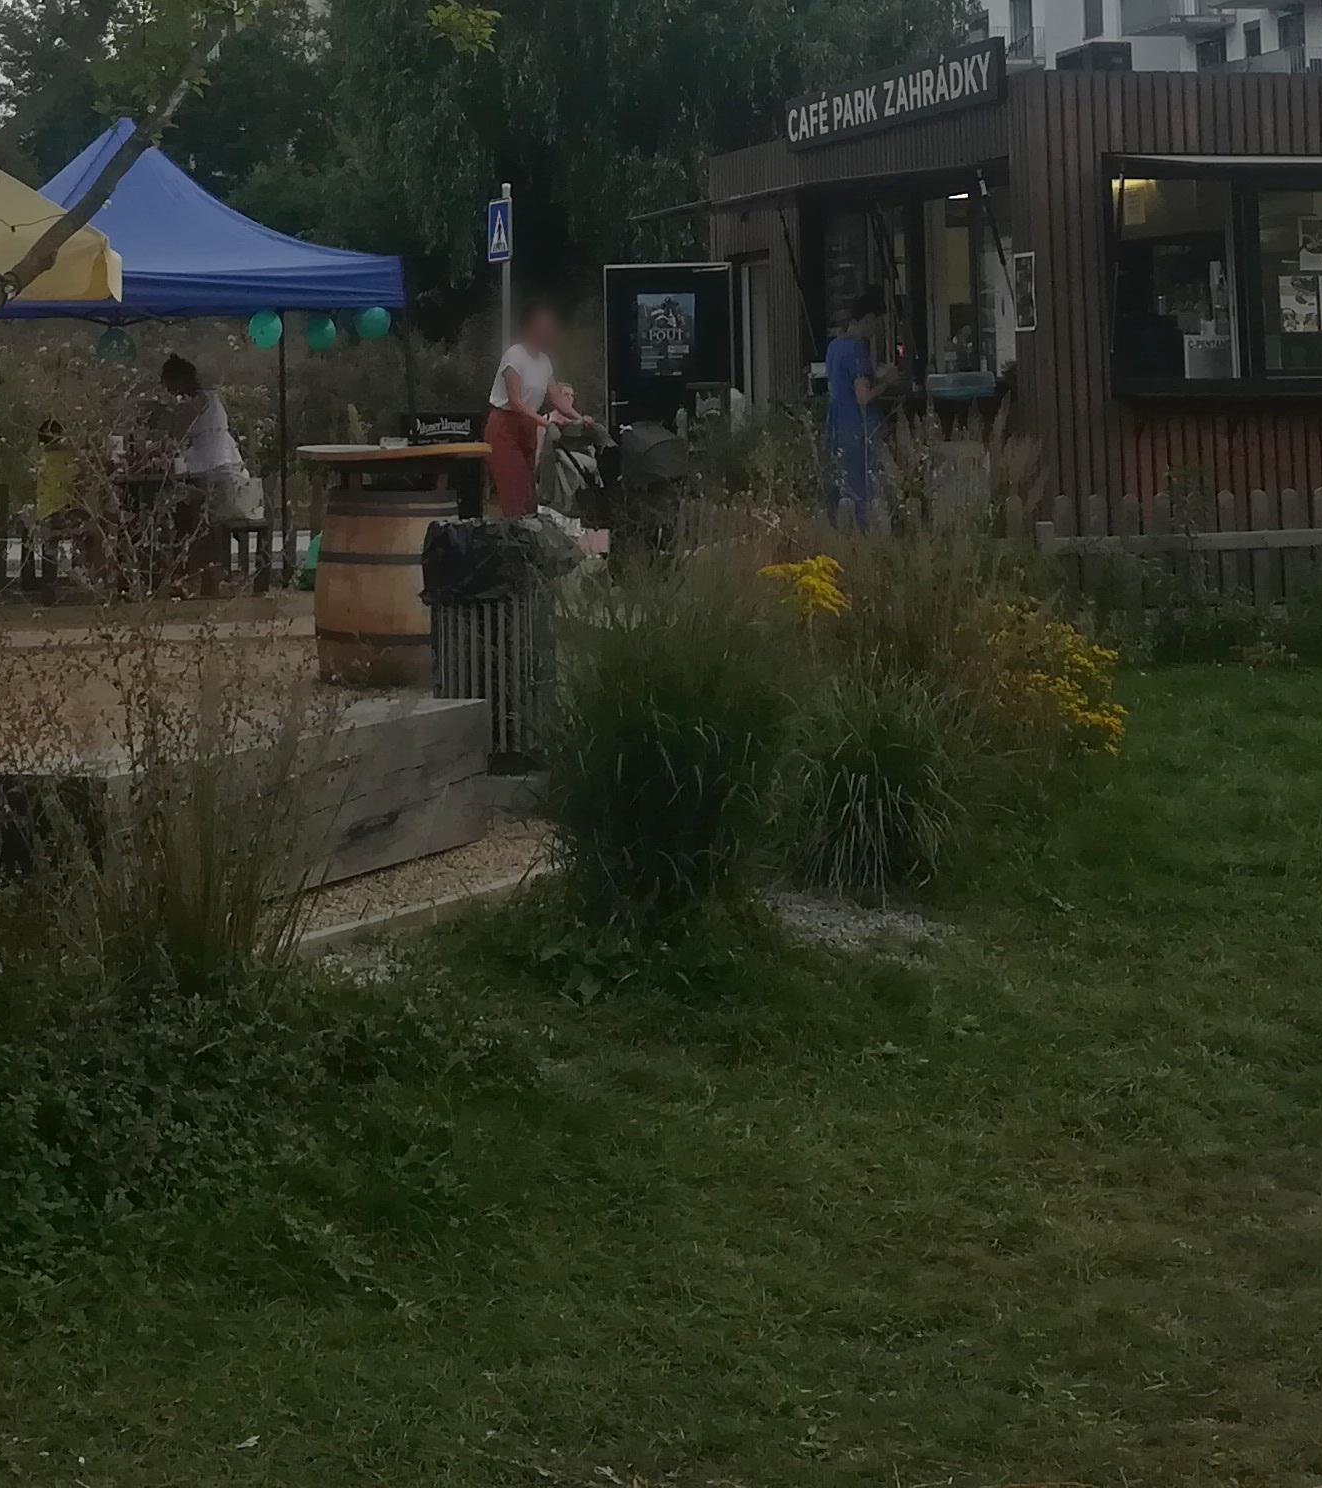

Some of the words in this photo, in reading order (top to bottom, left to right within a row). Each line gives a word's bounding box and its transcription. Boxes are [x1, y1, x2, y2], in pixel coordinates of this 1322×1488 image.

[787, 92, 829, 142] CAFÉ
[832, 85, 878, 131] PARK
[883, 50, 991, 118] ZAHRÁDKY
